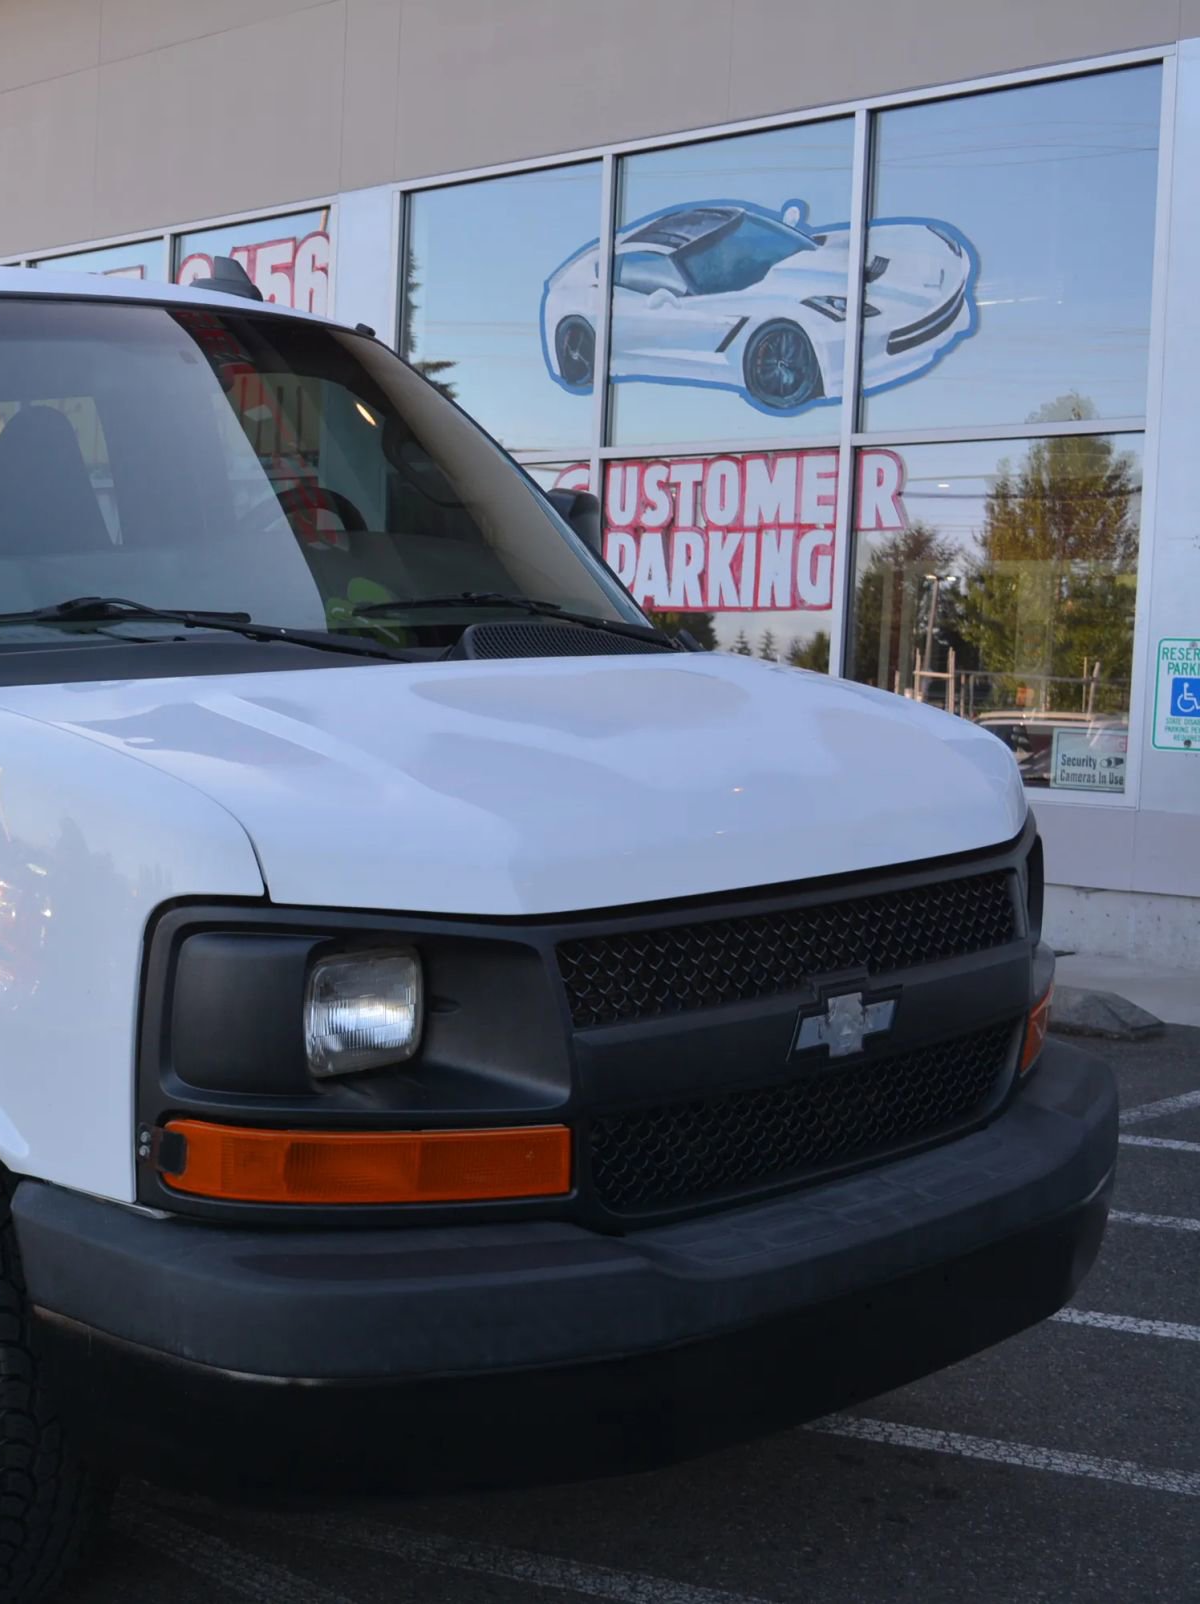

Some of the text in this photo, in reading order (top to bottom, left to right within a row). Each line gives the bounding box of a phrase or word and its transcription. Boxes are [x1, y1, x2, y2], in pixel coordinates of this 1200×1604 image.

[603, 527, 834, 613] PARKING
[1060, 754, 1097, 770] Security
[1060, 769, 1124, 785] Cameras In Use
